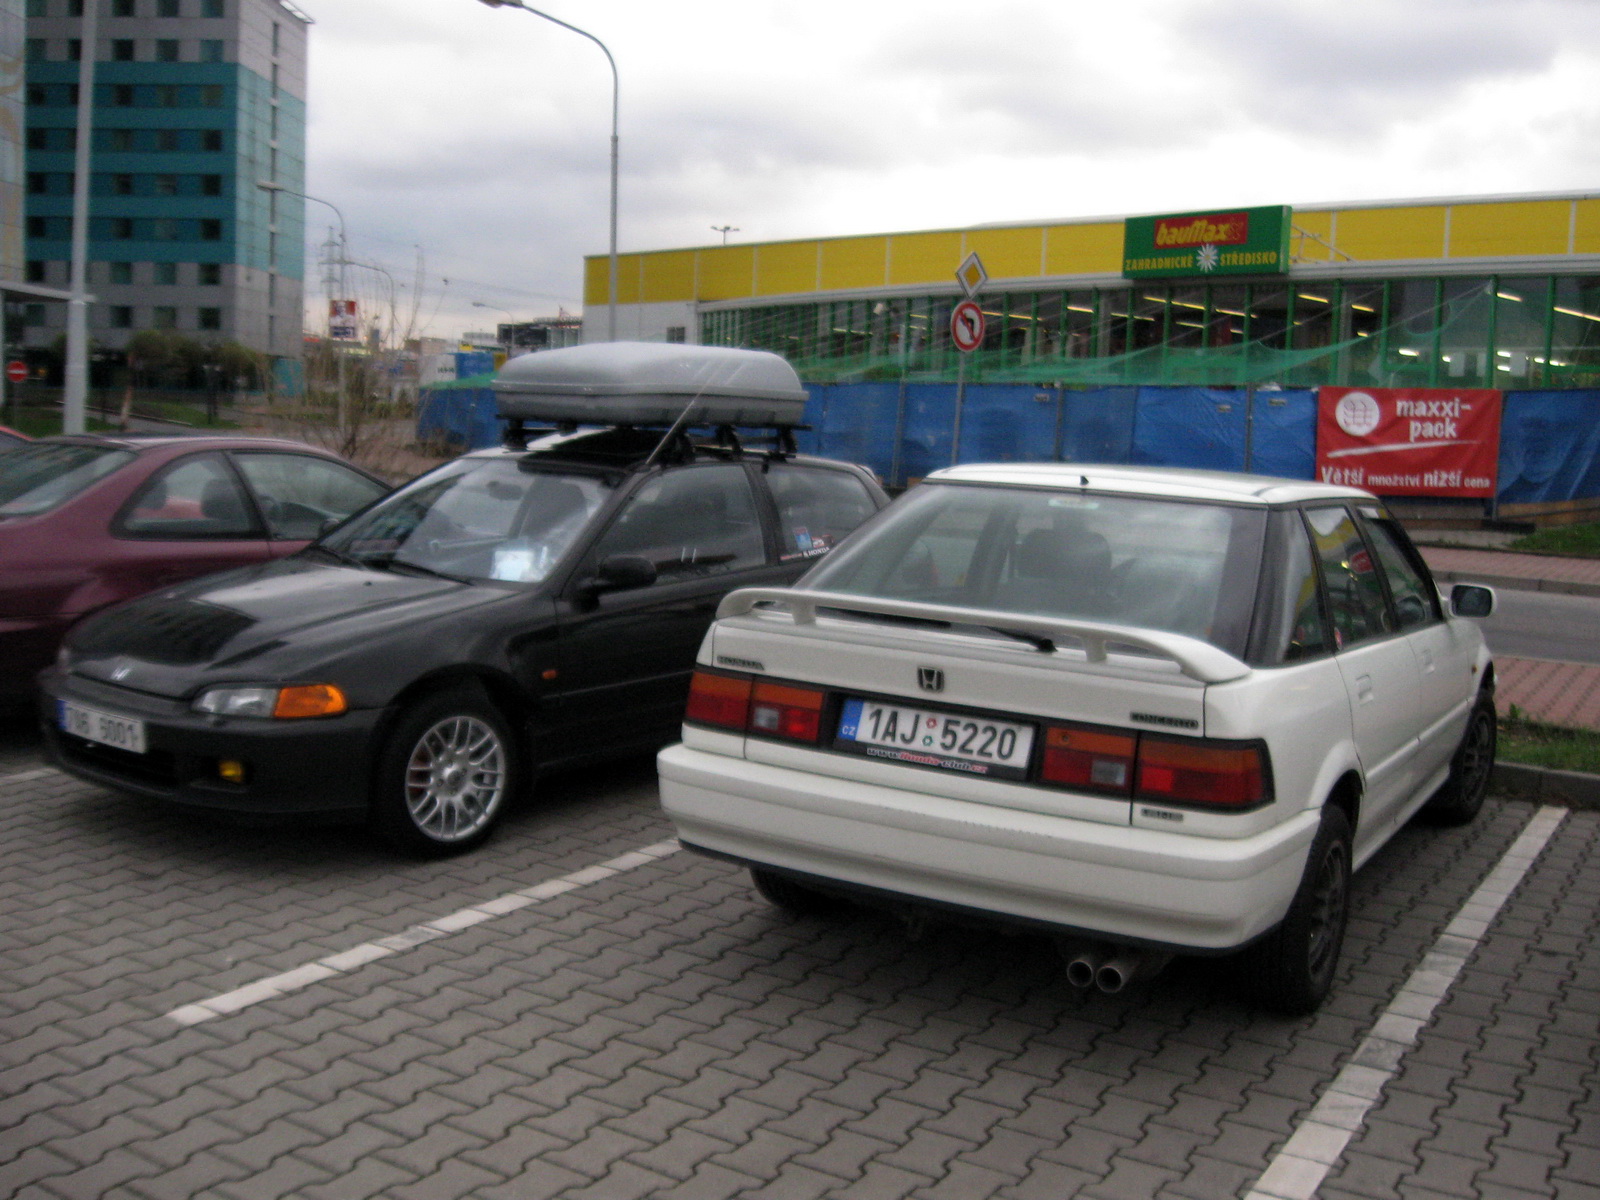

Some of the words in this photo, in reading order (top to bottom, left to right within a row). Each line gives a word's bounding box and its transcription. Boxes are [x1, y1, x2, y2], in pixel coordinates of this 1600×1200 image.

[1125, 254, 1194, 271] ZAHRADNICKÉ
[1220, 251, 1278, 266] STŘEDISKO
[1396, 397, 1472, 417] maxxi-
[1409, 417, 1457, 442] pack
[1423, 469, 1462, 488] nižší
[1464, 478, 1490, 488] cena
[842, 725, 855, 736] CZ
[869, 708, 920, 745] 1AJ
[940, 718, 1017, 760] 5220
